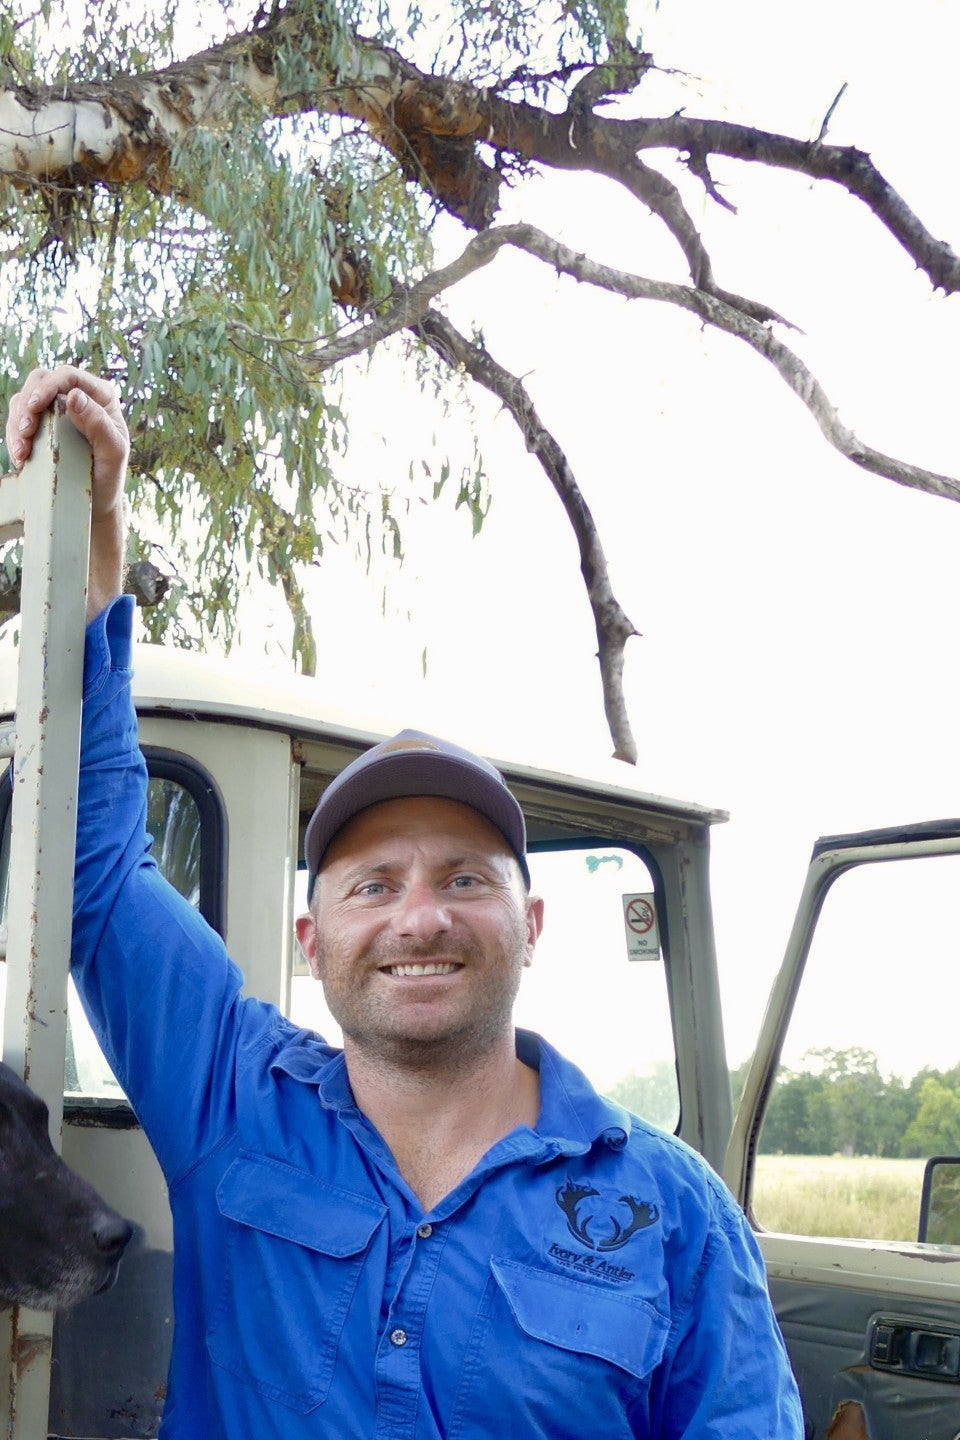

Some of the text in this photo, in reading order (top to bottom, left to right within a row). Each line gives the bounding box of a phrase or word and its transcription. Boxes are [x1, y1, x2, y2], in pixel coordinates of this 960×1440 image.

[637, 939, 648, 947] NO
[549, 1242, 636, 1281] Ivory & Antler
